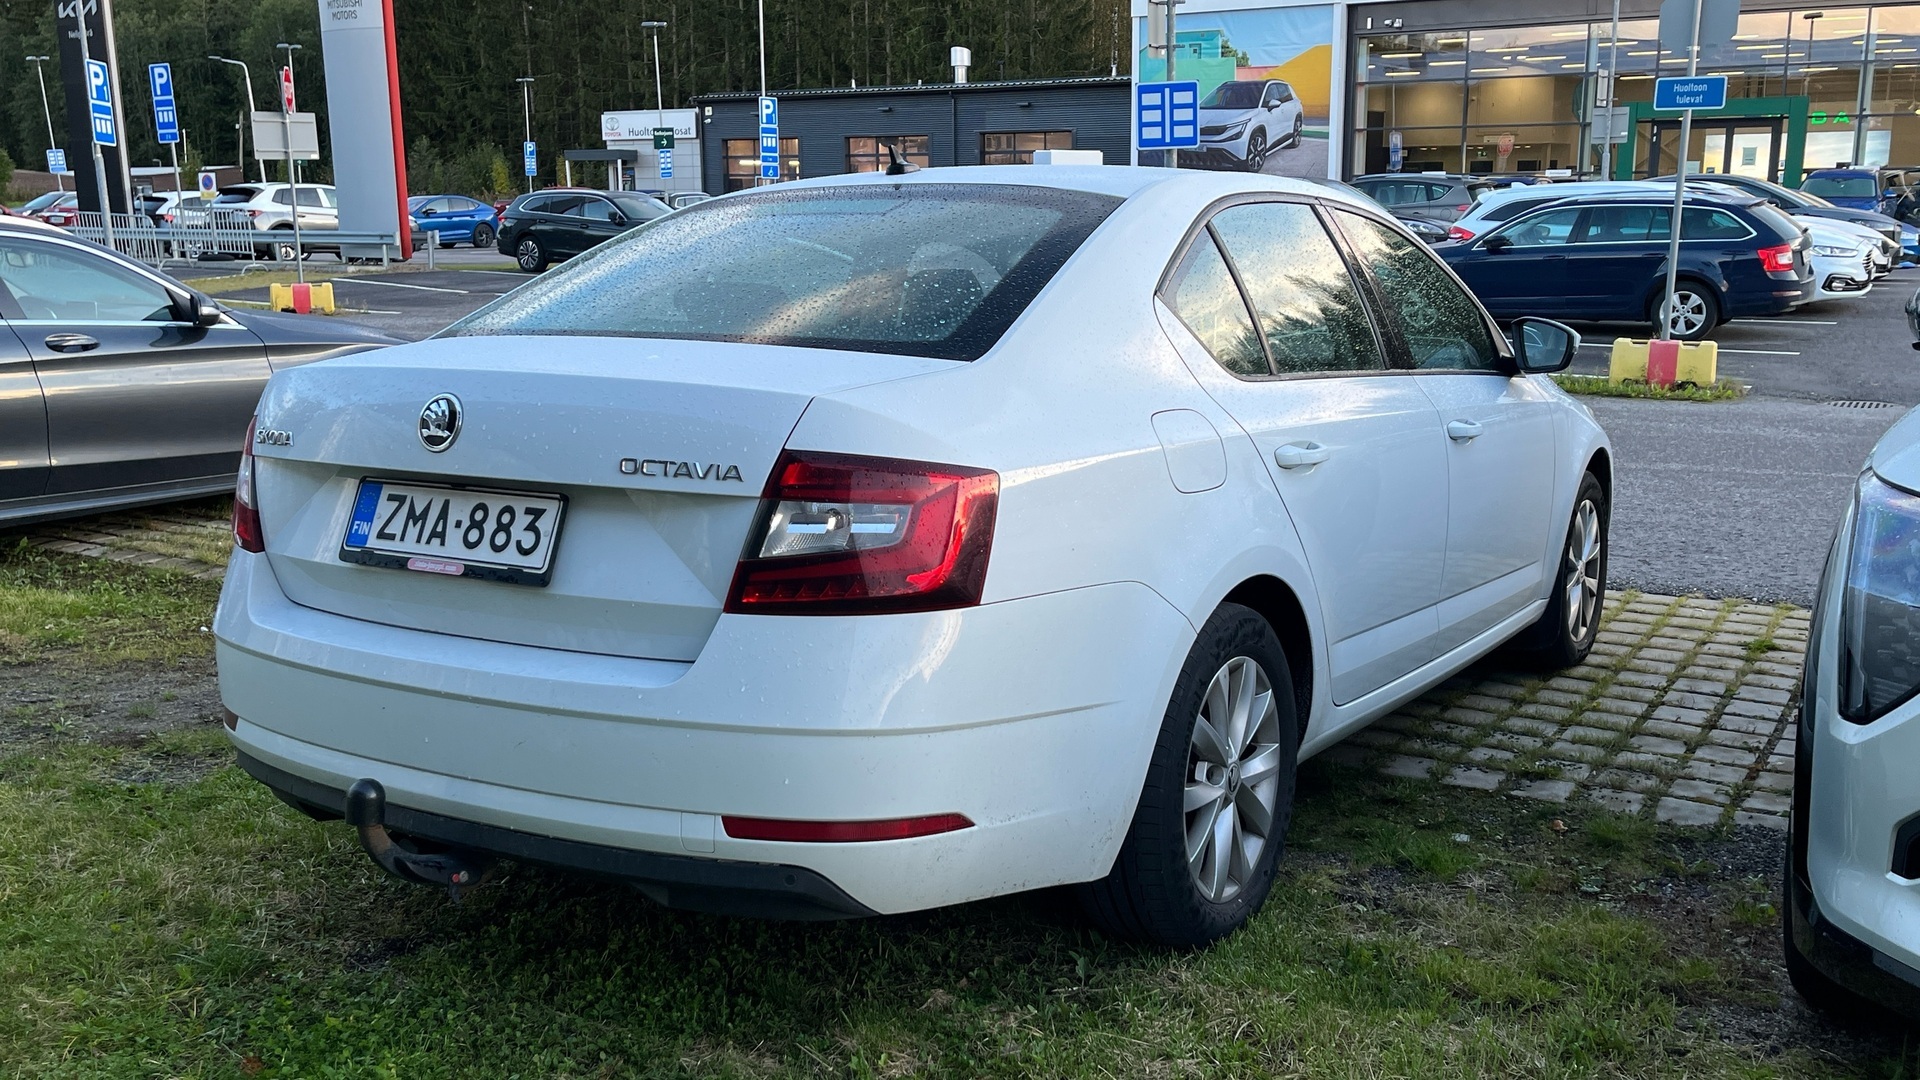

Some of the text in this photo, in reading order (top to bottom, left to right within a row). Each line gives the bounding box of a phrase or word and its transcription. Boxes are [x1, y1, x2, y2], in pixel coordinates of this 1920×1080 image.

[332, 10, 358, 21] MOTORS
[153, 67, 167, 95] P
[1673, 83, 1708, 92] Huoltoon
[1676, 94, 1703, 104] tulevat
[526, 143, 534, 156] P
[619, 457, 744, 482] OCTAVIA
[351, 520, 372, 536] FIN
